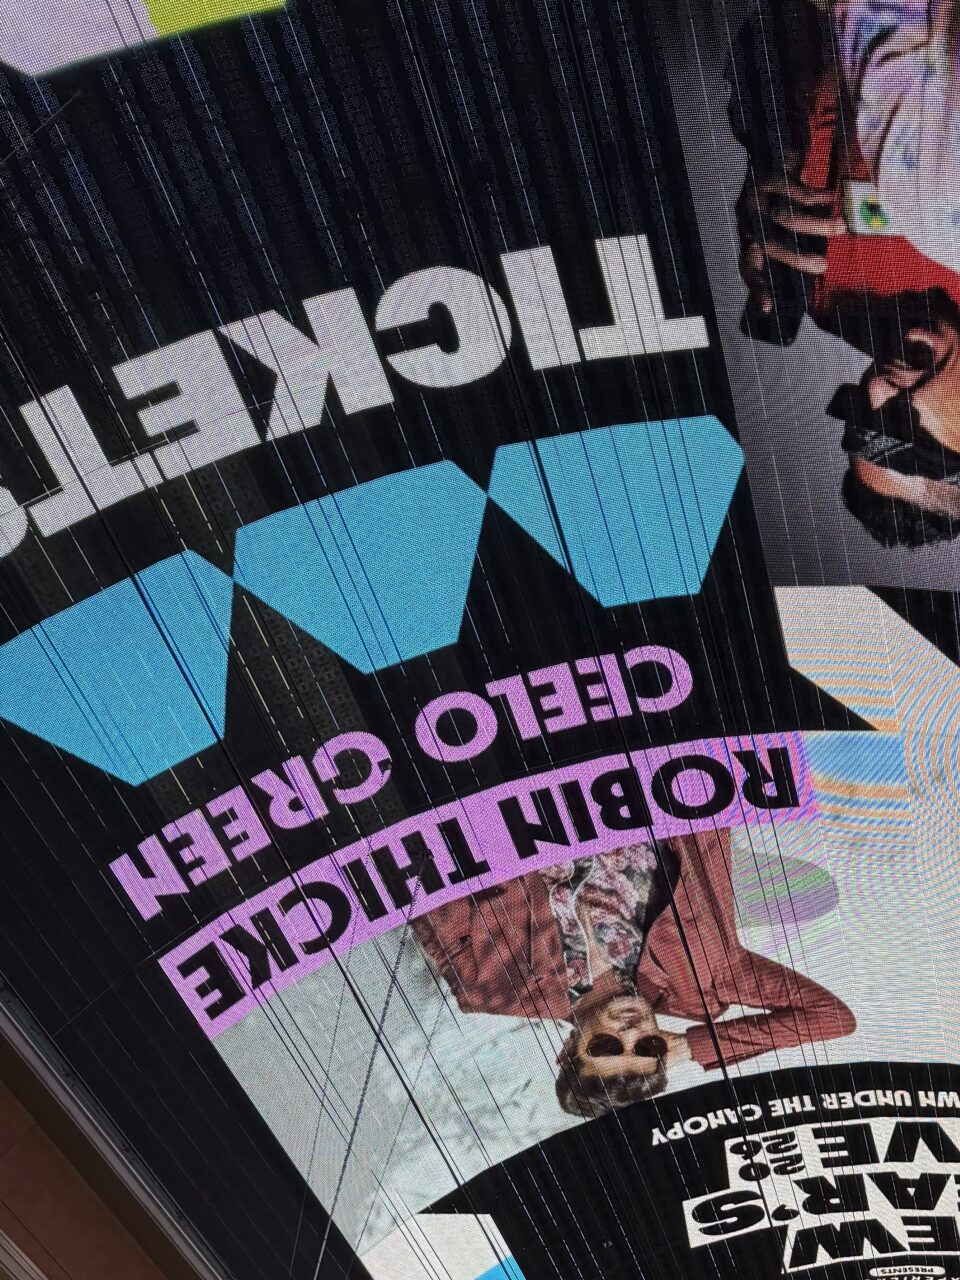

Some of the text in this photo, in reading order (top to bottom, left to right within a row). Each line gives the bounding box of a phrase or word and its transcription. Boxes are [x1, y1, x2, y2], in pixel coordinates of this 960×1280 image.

[109, 644, 694, 921] CEELO GREEN
[175, 747, 801, 1021] ROBIN THICKE
[768, 1094, 816, 1117] THE
[820, 1089, 911, 1110] UNDER
[651, 1104, 763, 1147] CANOPY
[879, 1266, 935, 1276] PRESENTS
